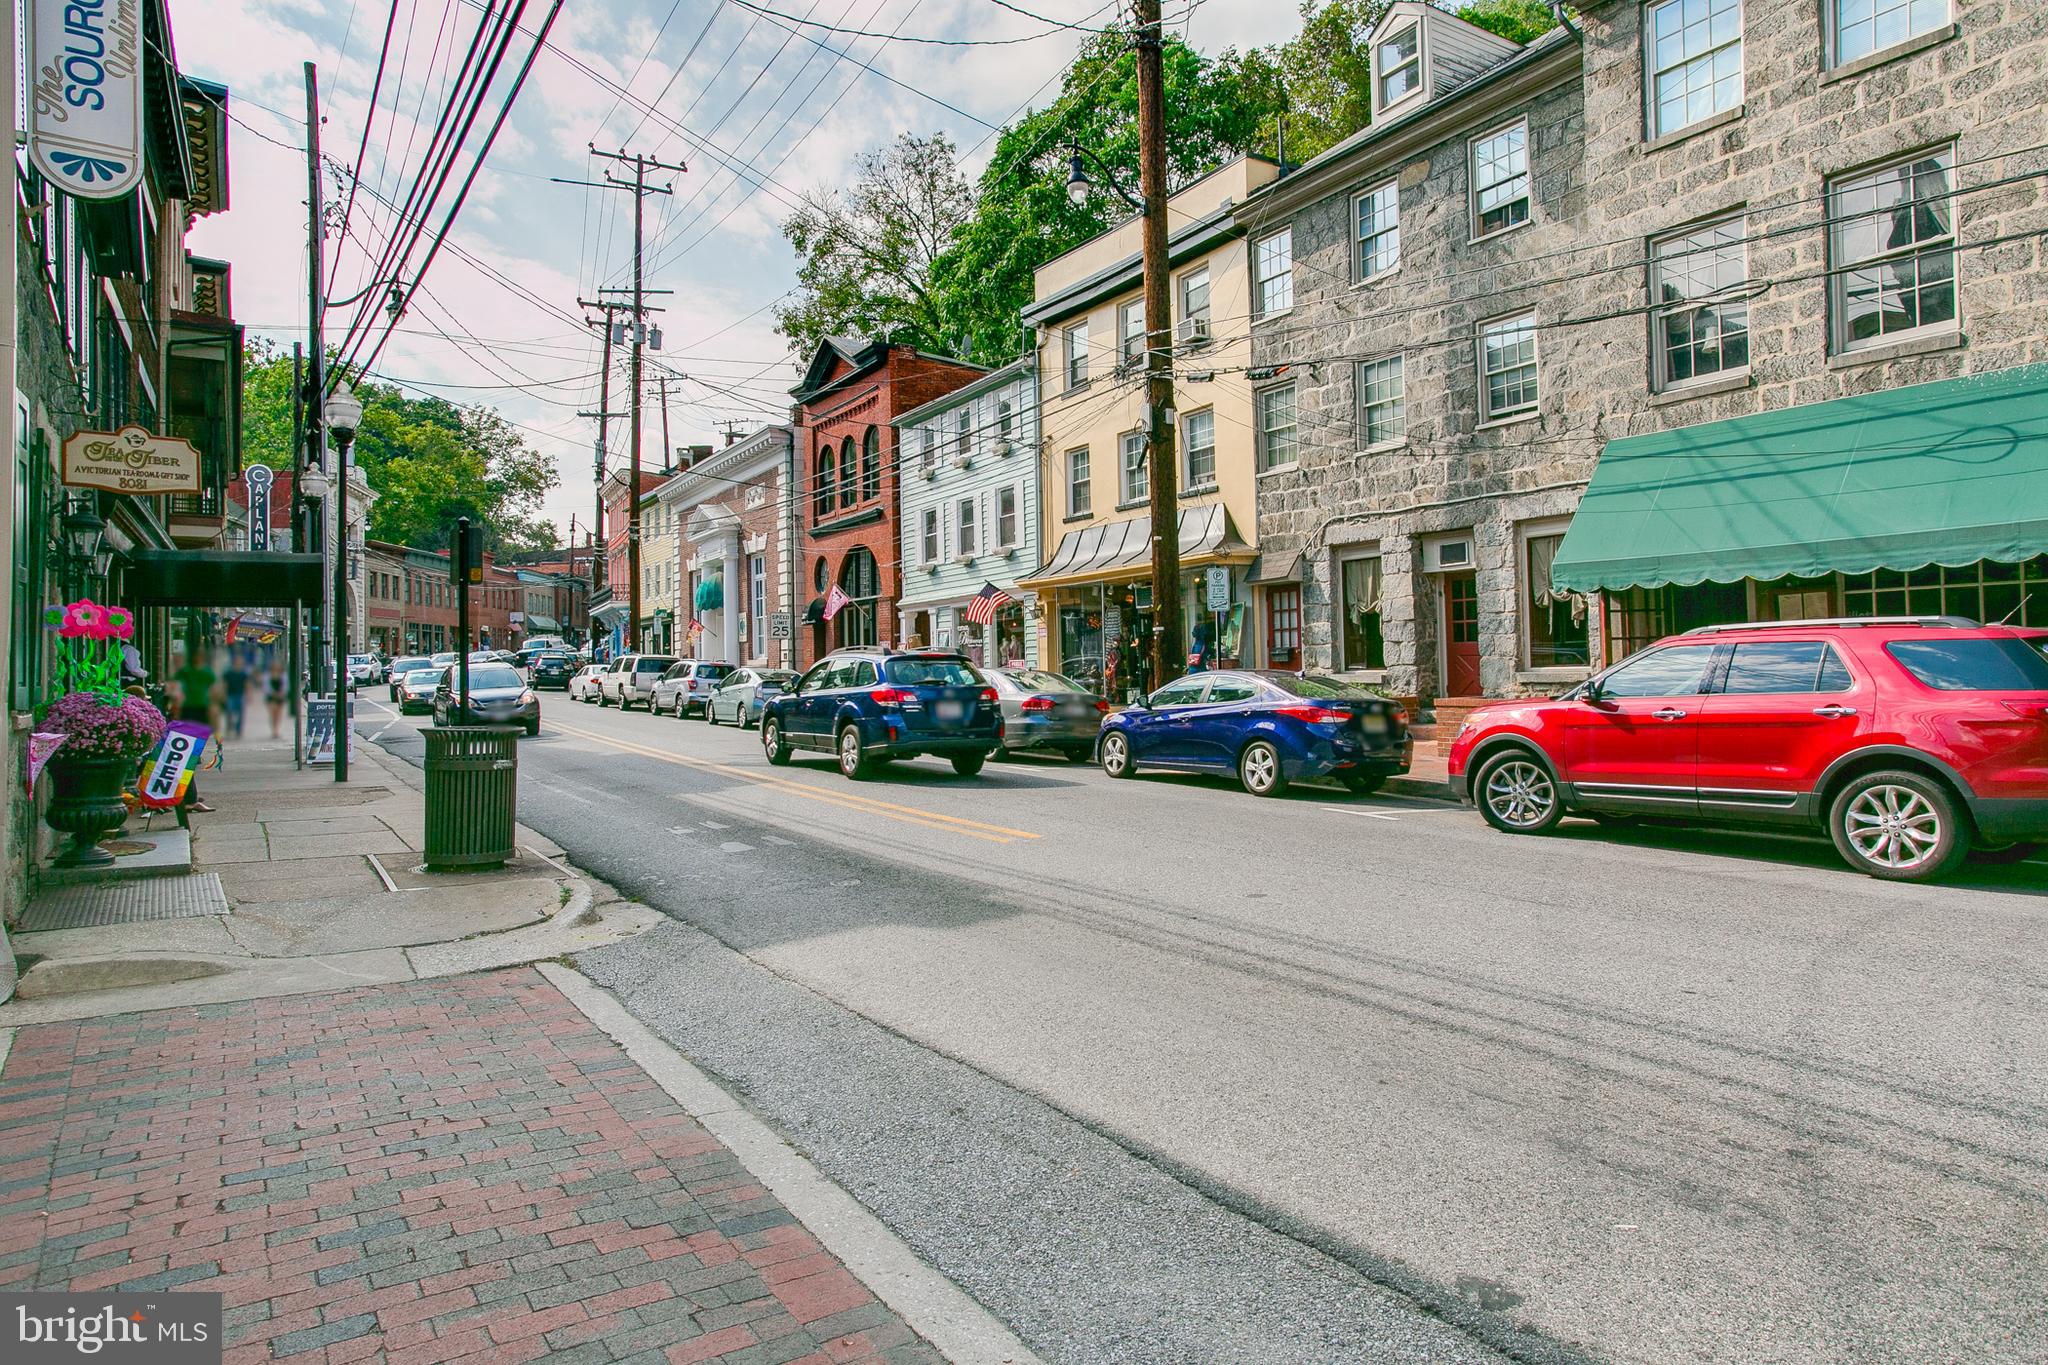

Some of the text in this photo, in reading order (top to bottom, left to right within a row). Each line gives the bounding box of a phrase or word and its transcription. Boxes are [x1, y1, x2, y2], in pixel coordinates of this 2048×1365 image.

[33, 55, 68, 122] The
[124, 448, 180, 469] TIBER
[772, 626, 789, 636] 25
[152, 737, 189, 795] OPEN
